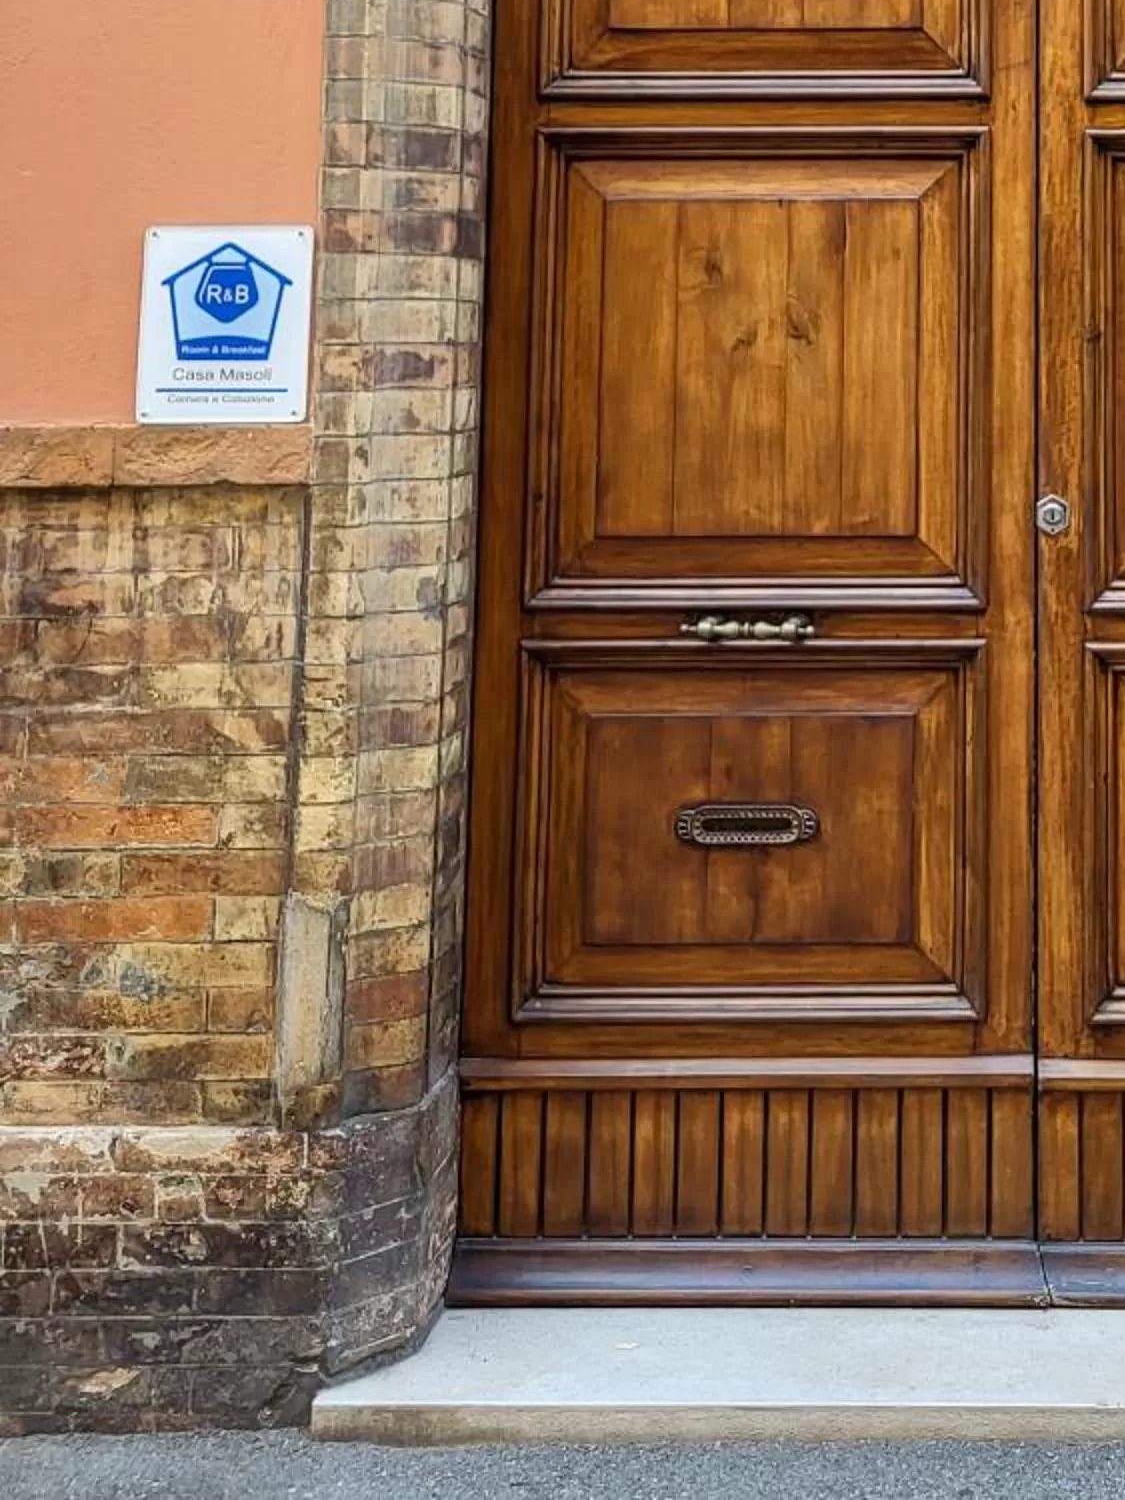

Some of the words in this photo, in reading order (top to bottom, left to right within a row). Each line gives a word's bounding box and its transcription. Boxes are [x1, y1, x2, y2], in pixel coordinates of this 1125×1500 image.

[206, 283, 250, 304] R&B
[181, 346, 210, 355] Room
[221, 345, 267, 355] Breakfast
[172, 368, 217, 381] Casa
[219, 367, 272, 382] Masoli
